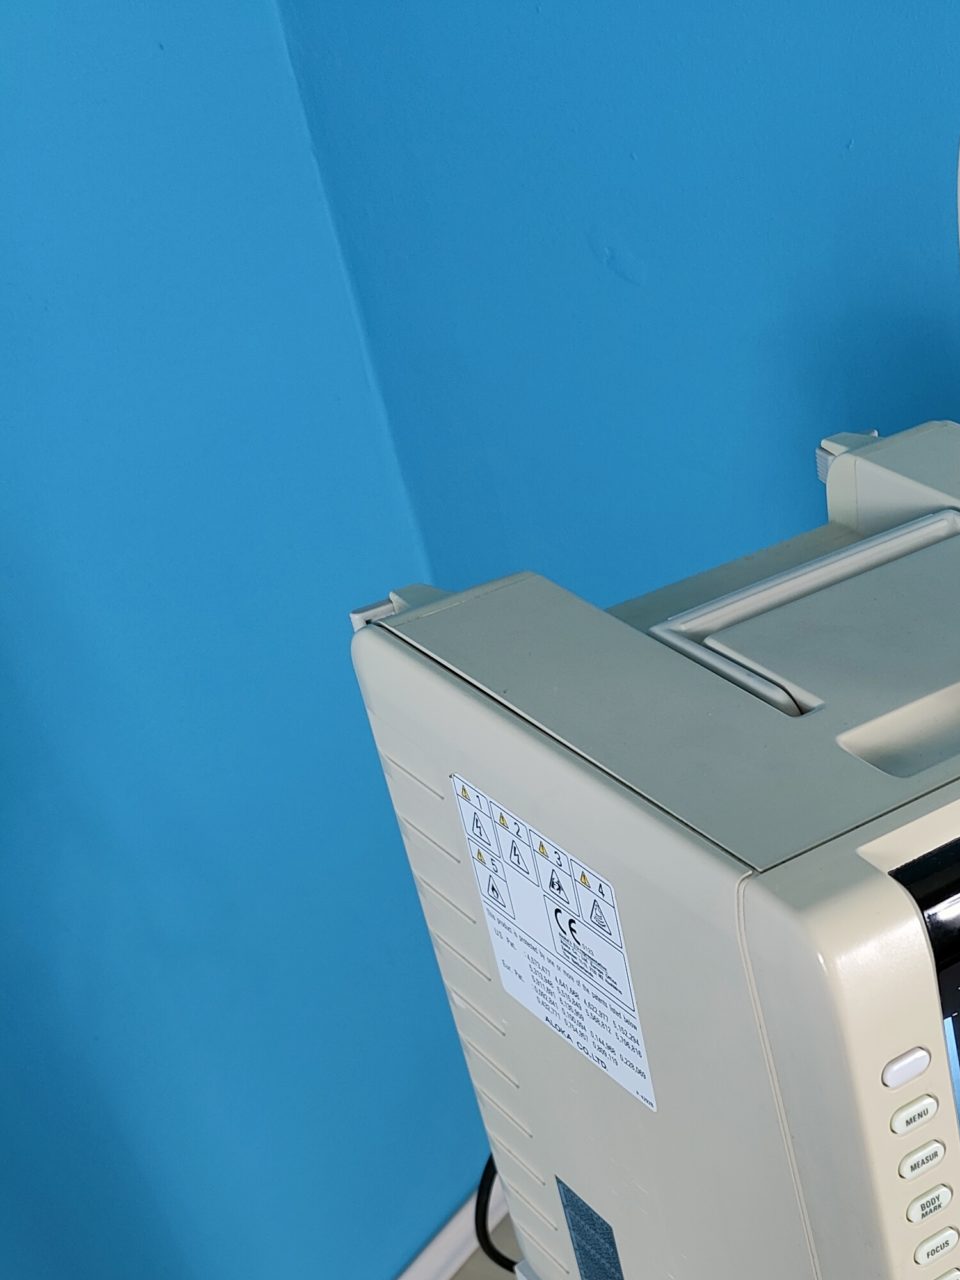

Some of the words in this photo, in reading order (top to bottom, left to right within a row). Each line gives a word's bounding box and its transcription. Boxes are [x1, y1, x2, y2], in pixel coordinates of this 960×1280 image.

[476, 795, 483, 810] 1
[513, 821, 522, 839] 2
[490, 858, 498, 874] 5
[553, 851, 563, 868] 3
[598, 883, 605, 898] 4
[905, 1108, 929, 1128] MENU
[909, 1150, 939, 1173] MEASUR
[920, 1194, 941, 1212] BODY
[920, 1202, 943, 1220] MARK
[926, 1239, 950, 1260] FOCUS
